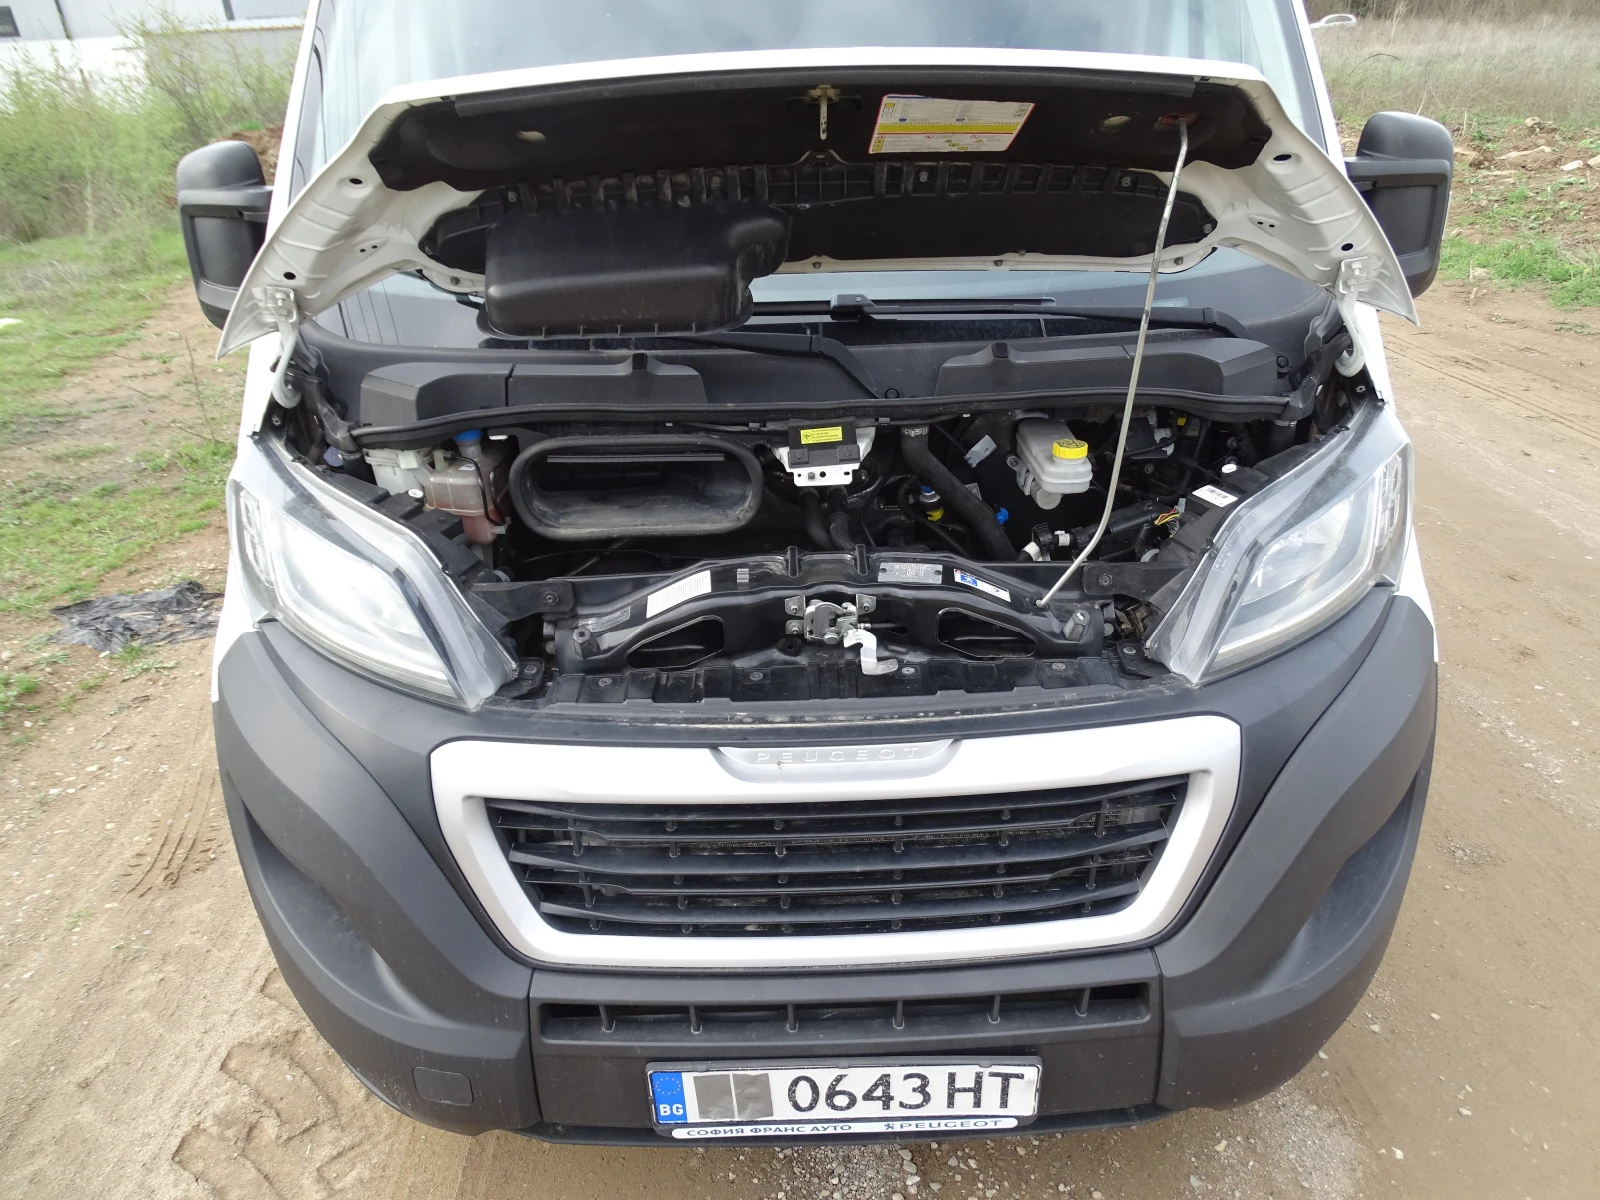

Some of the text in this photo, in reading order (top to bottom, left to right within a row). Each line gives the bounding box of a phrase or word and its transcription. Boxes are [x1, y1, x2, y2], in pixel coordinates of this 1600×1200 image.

[755, 747, 919, 763] PEUGEOT
[787, 1072, 932, 1113] 0643
[659, 1103, 684, 1117] BG
[686, 1124, 852, 1137] СОФИЯ ФРАНС АУТО
[899, 1119, 1003, 1130] PEUGEOT
